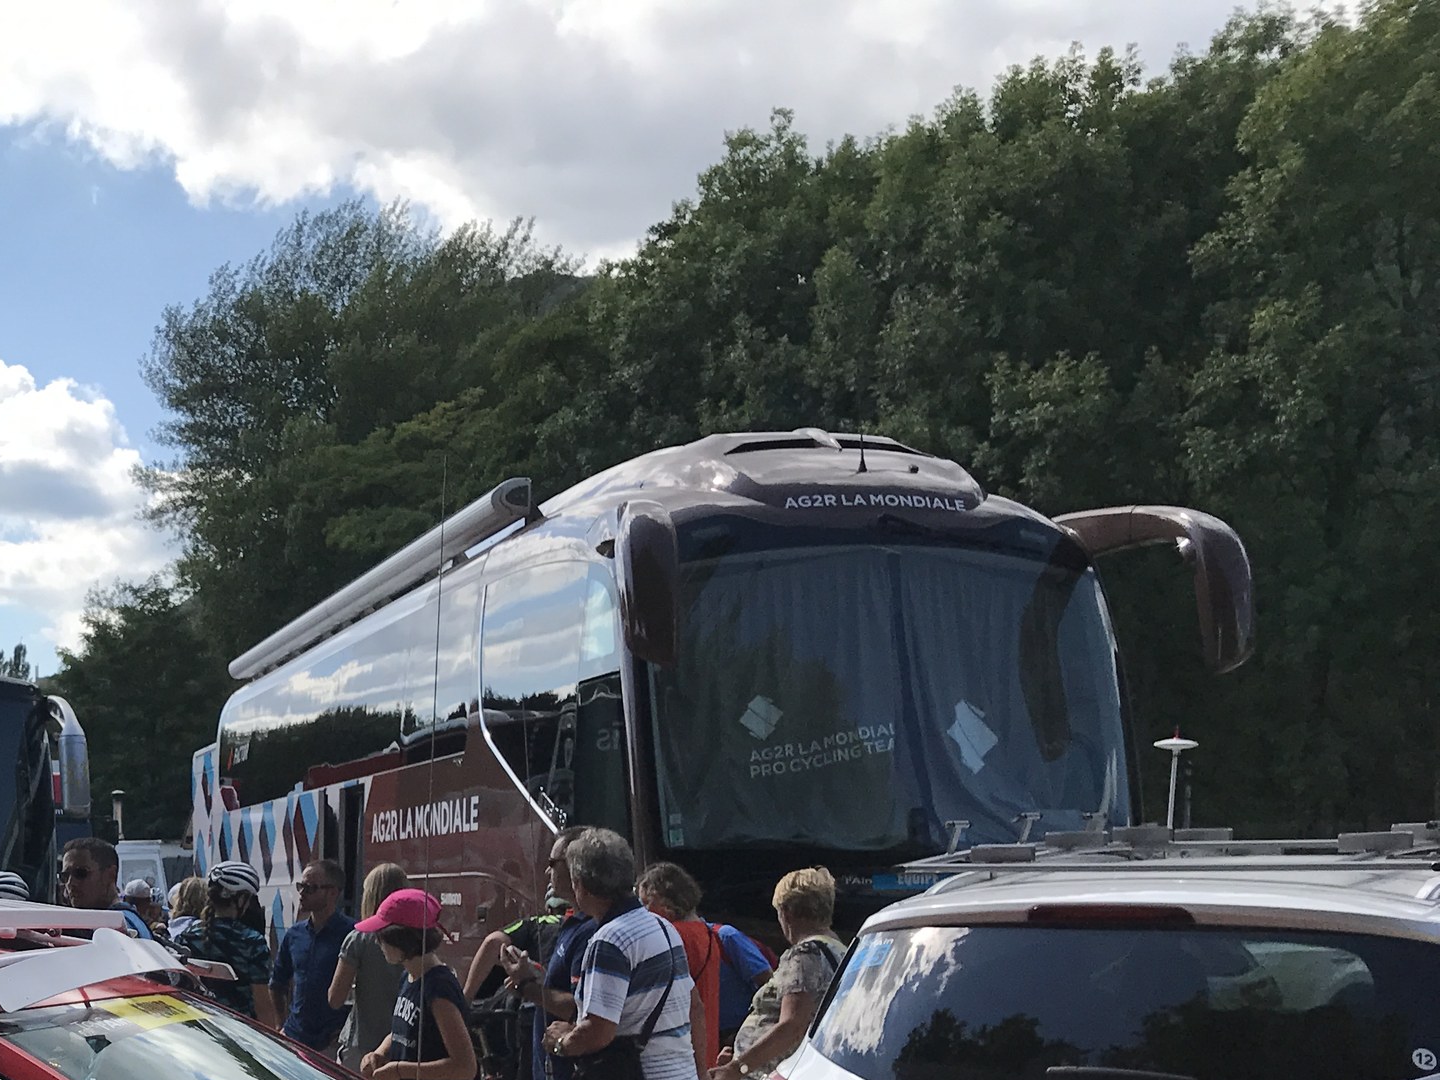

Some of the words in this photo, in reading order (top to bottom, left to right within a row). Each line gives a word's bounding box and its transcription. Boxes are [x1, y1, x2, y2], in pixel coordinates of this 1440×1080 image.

[784, 494, 837, 510] AG2R
[841, 493, 866, 507] LA
[869, 493, 967, 512] MONDIALE
[750, 743, 795, 762] AG2R
[798, 740, 821, 756] LA
[750, 761, 786, 778] PRO
[790, 746, 861, 773] CYCLING
[371, 810, 397, 843] AG2R
[400, 806, 413, 840] LA
[415, 795, 479, 838] MONDIALE
[1415, 1052, 1434, 1067] 12
